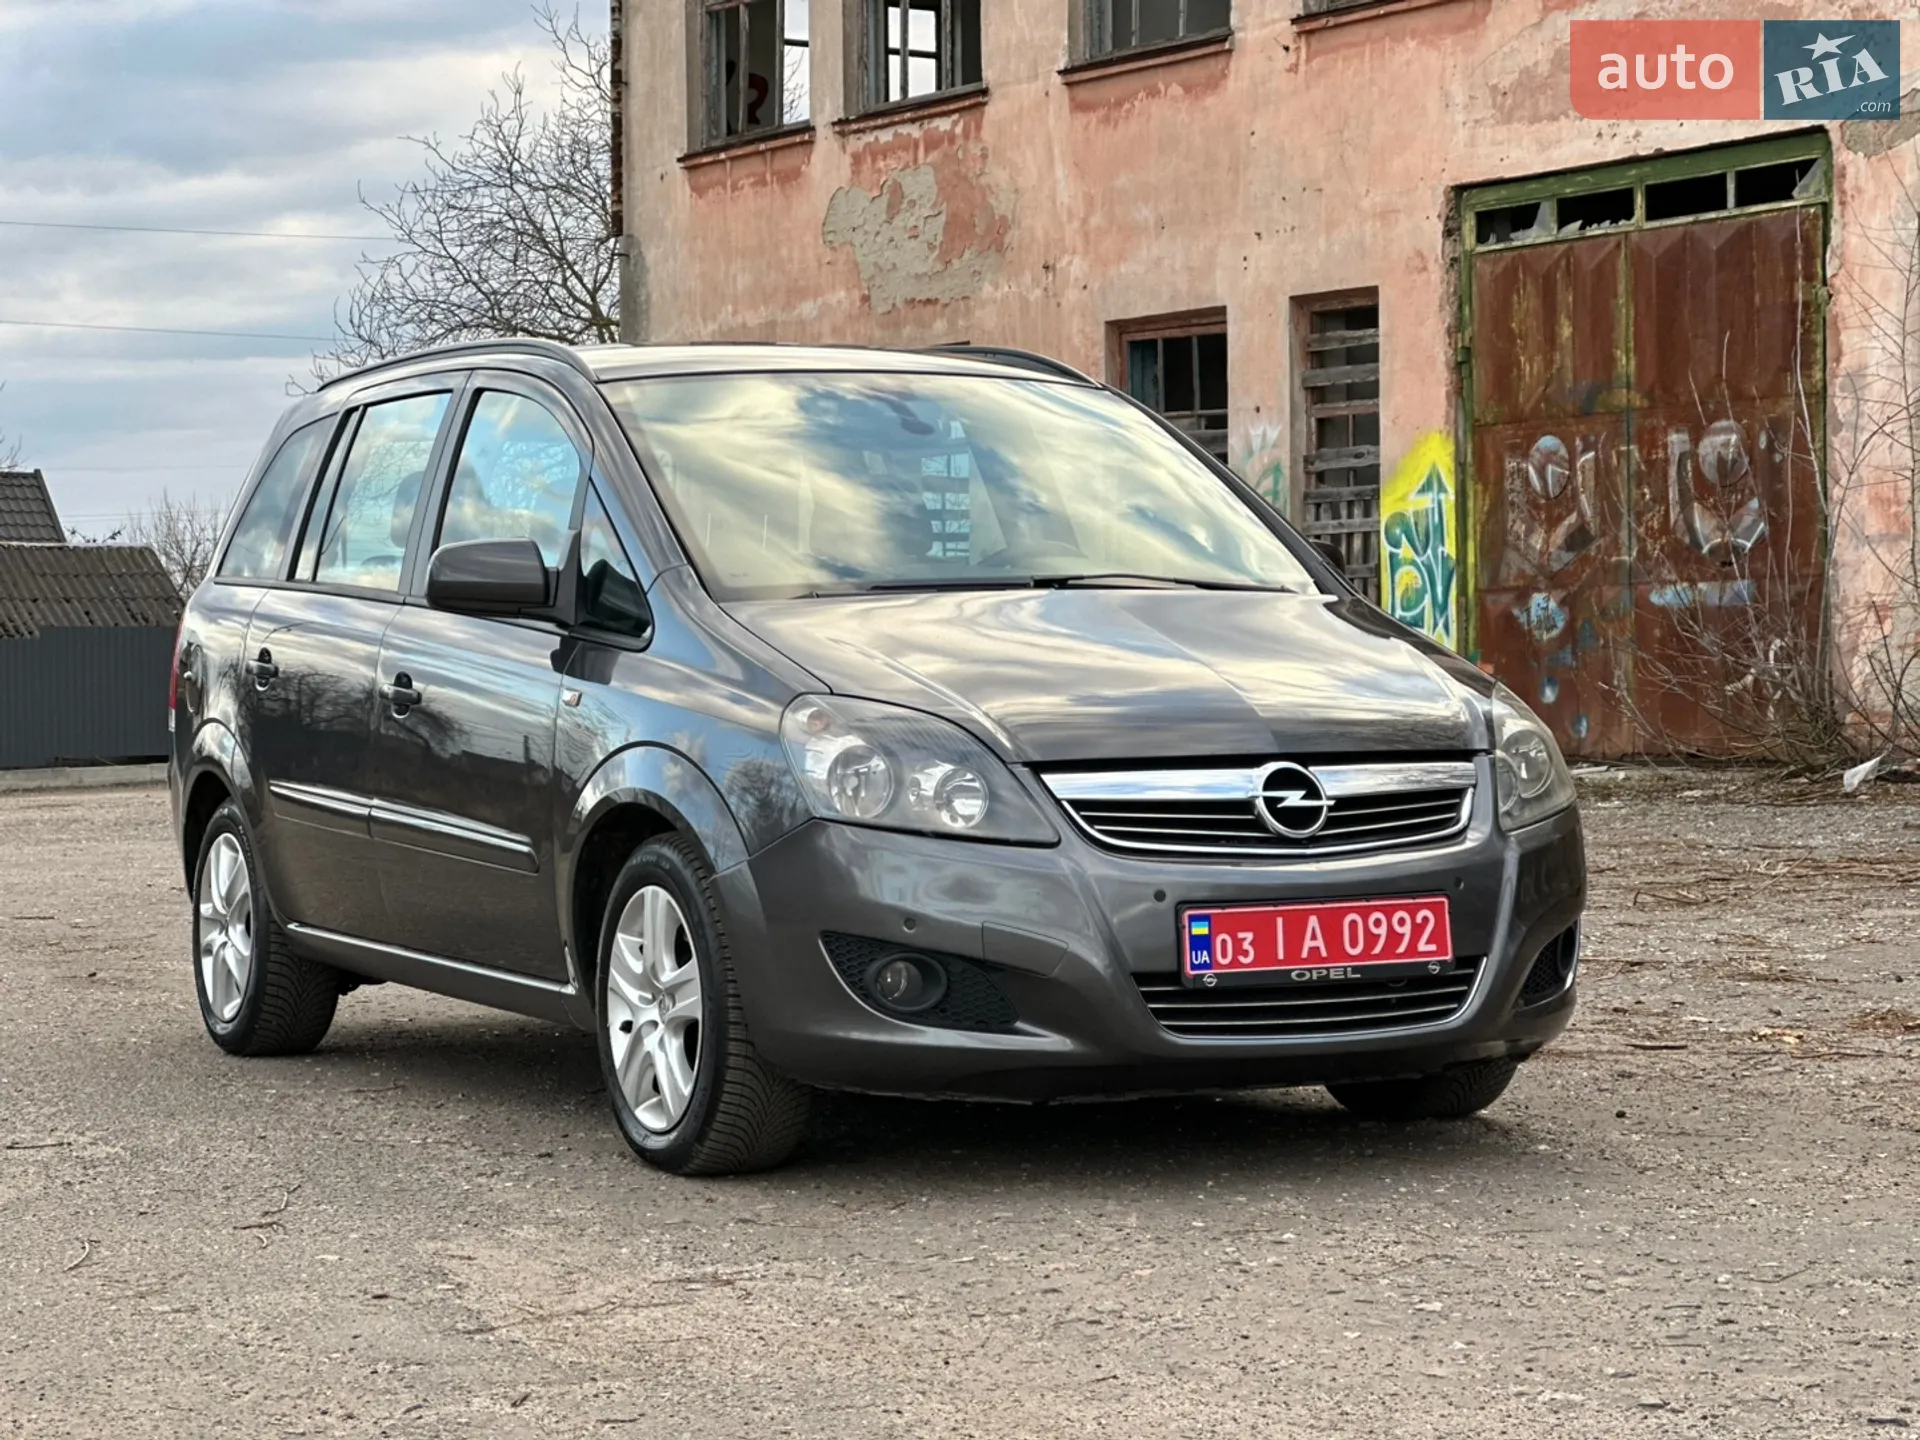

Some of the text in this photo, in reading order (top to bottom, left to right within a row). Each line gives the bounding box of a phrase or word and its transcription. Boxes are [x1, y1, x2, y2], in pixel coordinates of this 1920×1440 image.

[1192, 909, 1437, 965] UA 03 IA 0992
[1291, 967, 1361, 981] OPEL
